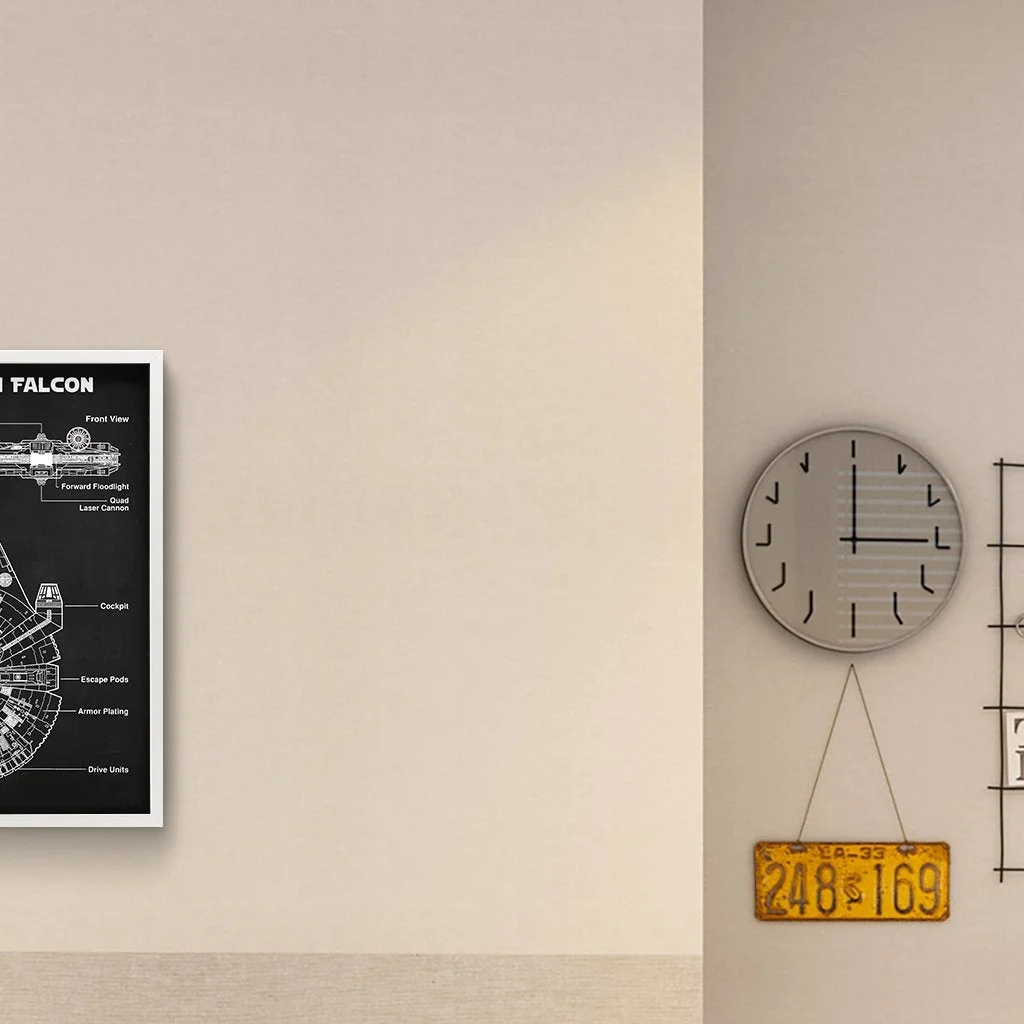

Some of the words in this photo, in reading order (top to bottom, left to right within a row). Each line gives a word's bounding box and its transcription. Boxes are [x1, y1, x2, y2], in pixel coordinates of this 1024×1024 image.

[11, 377, 94, 393] FALCON
[86, 415, 108, 423] Front
[110, 415, 129, 423] View
[61, 483, 91, 491] Forward
[92, 483, 129, 492] Floodlight
[110, 497, 129, 505] Quad
[100, 602, 129, 612] Cockpit
[81, 675, 107, 685] Escape
[109, 675, 129, 684] Pods
[78, 707, 100, 715] Armor
[103, 707, 129, 717] Plating
[88, 766, 108, 774] Drive
[110, 766, 129, 774] Units
[764, 862, 838, 916] 248
[874, 862, 941, 916] 169
